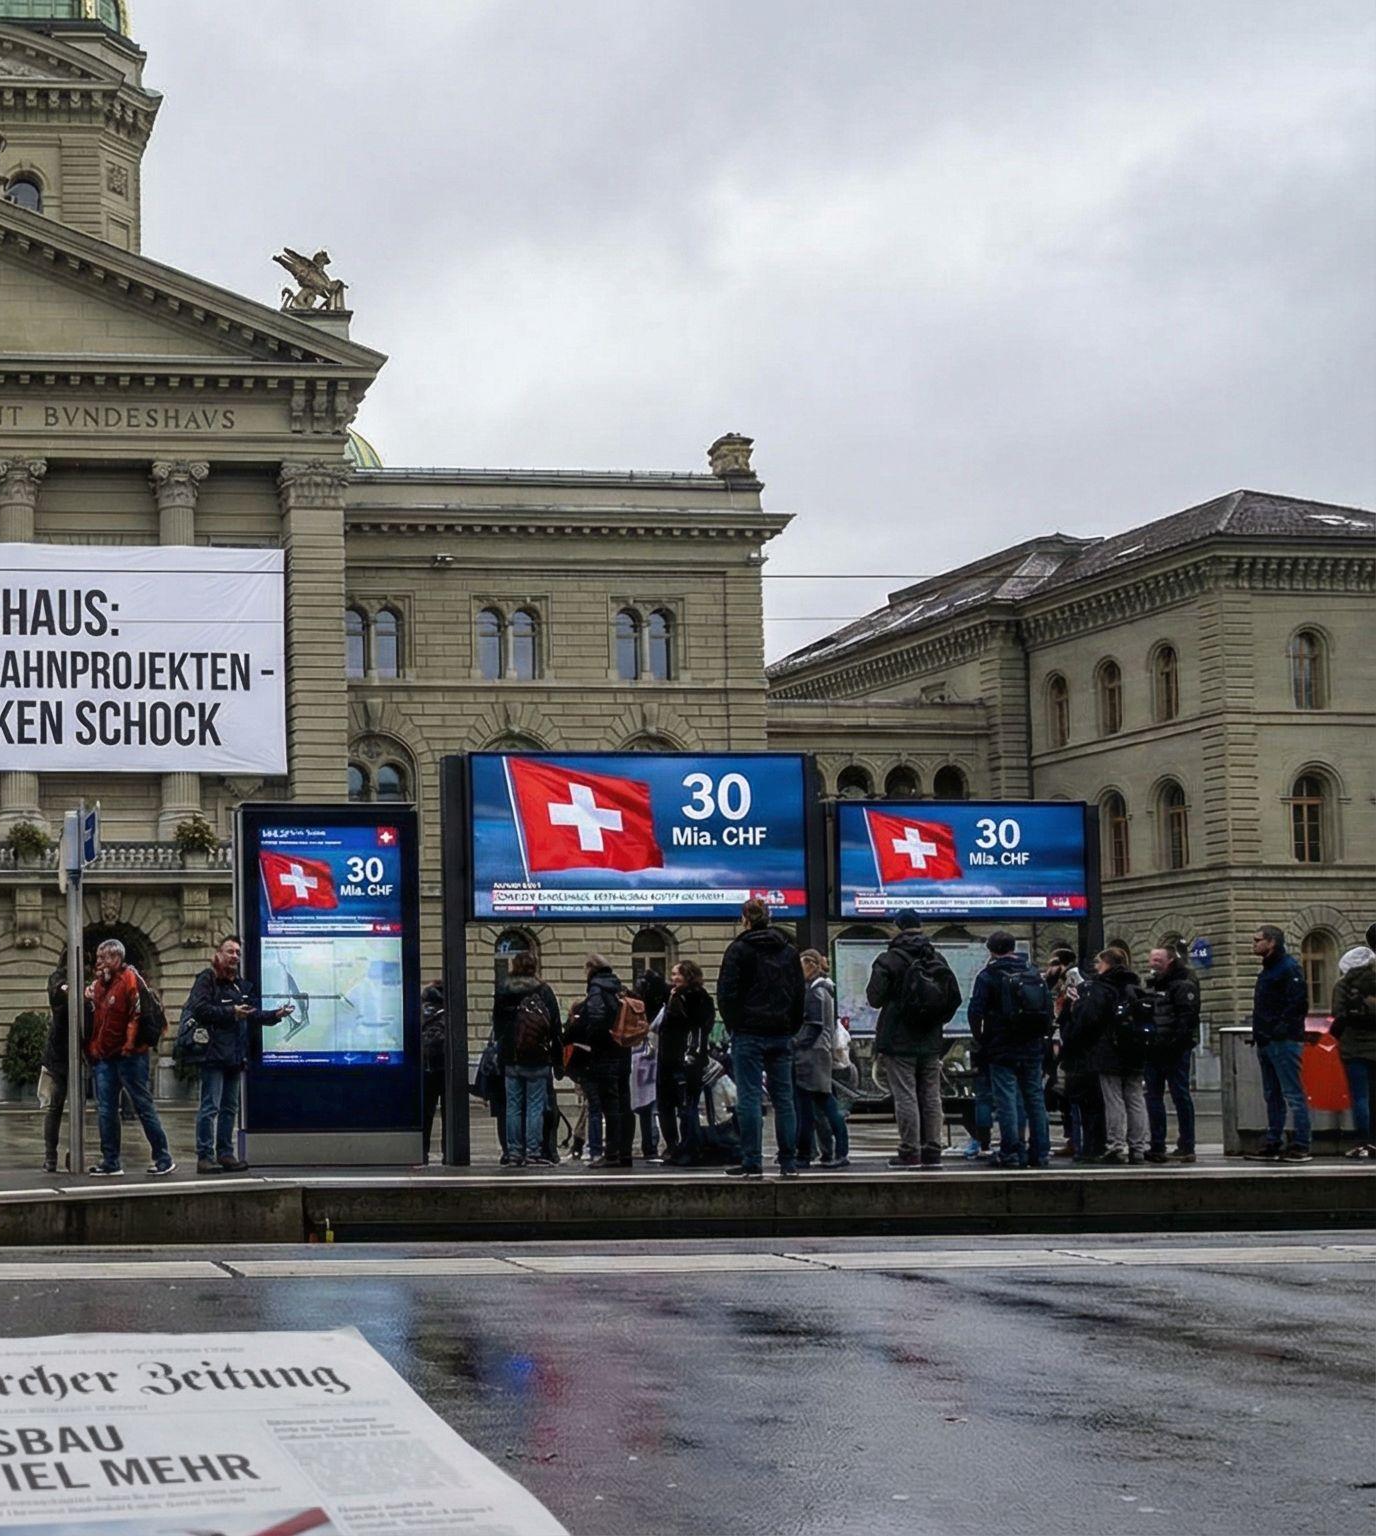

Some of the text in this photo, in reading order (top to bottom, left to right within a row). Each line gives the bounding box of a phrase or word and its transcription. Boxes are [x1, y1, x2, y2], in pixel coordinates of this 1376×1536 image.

[44, 406, 235, 430] BVNDESHAVS
[75, 700, 222, 747] SCHOCK
[681, 772, 751, 821] 30
[672, 826, 767, 846] Mia. CHF
[975, 818, 1021, 849] 30
[346, 856, 384, 883] 30
[1000, 852, 1030, 866] CHF
[367, 884, 393, 896] CHF
[137, 1360, 352, 1395] Zeitung
[99, 1453, 261, 1487] MEHR
